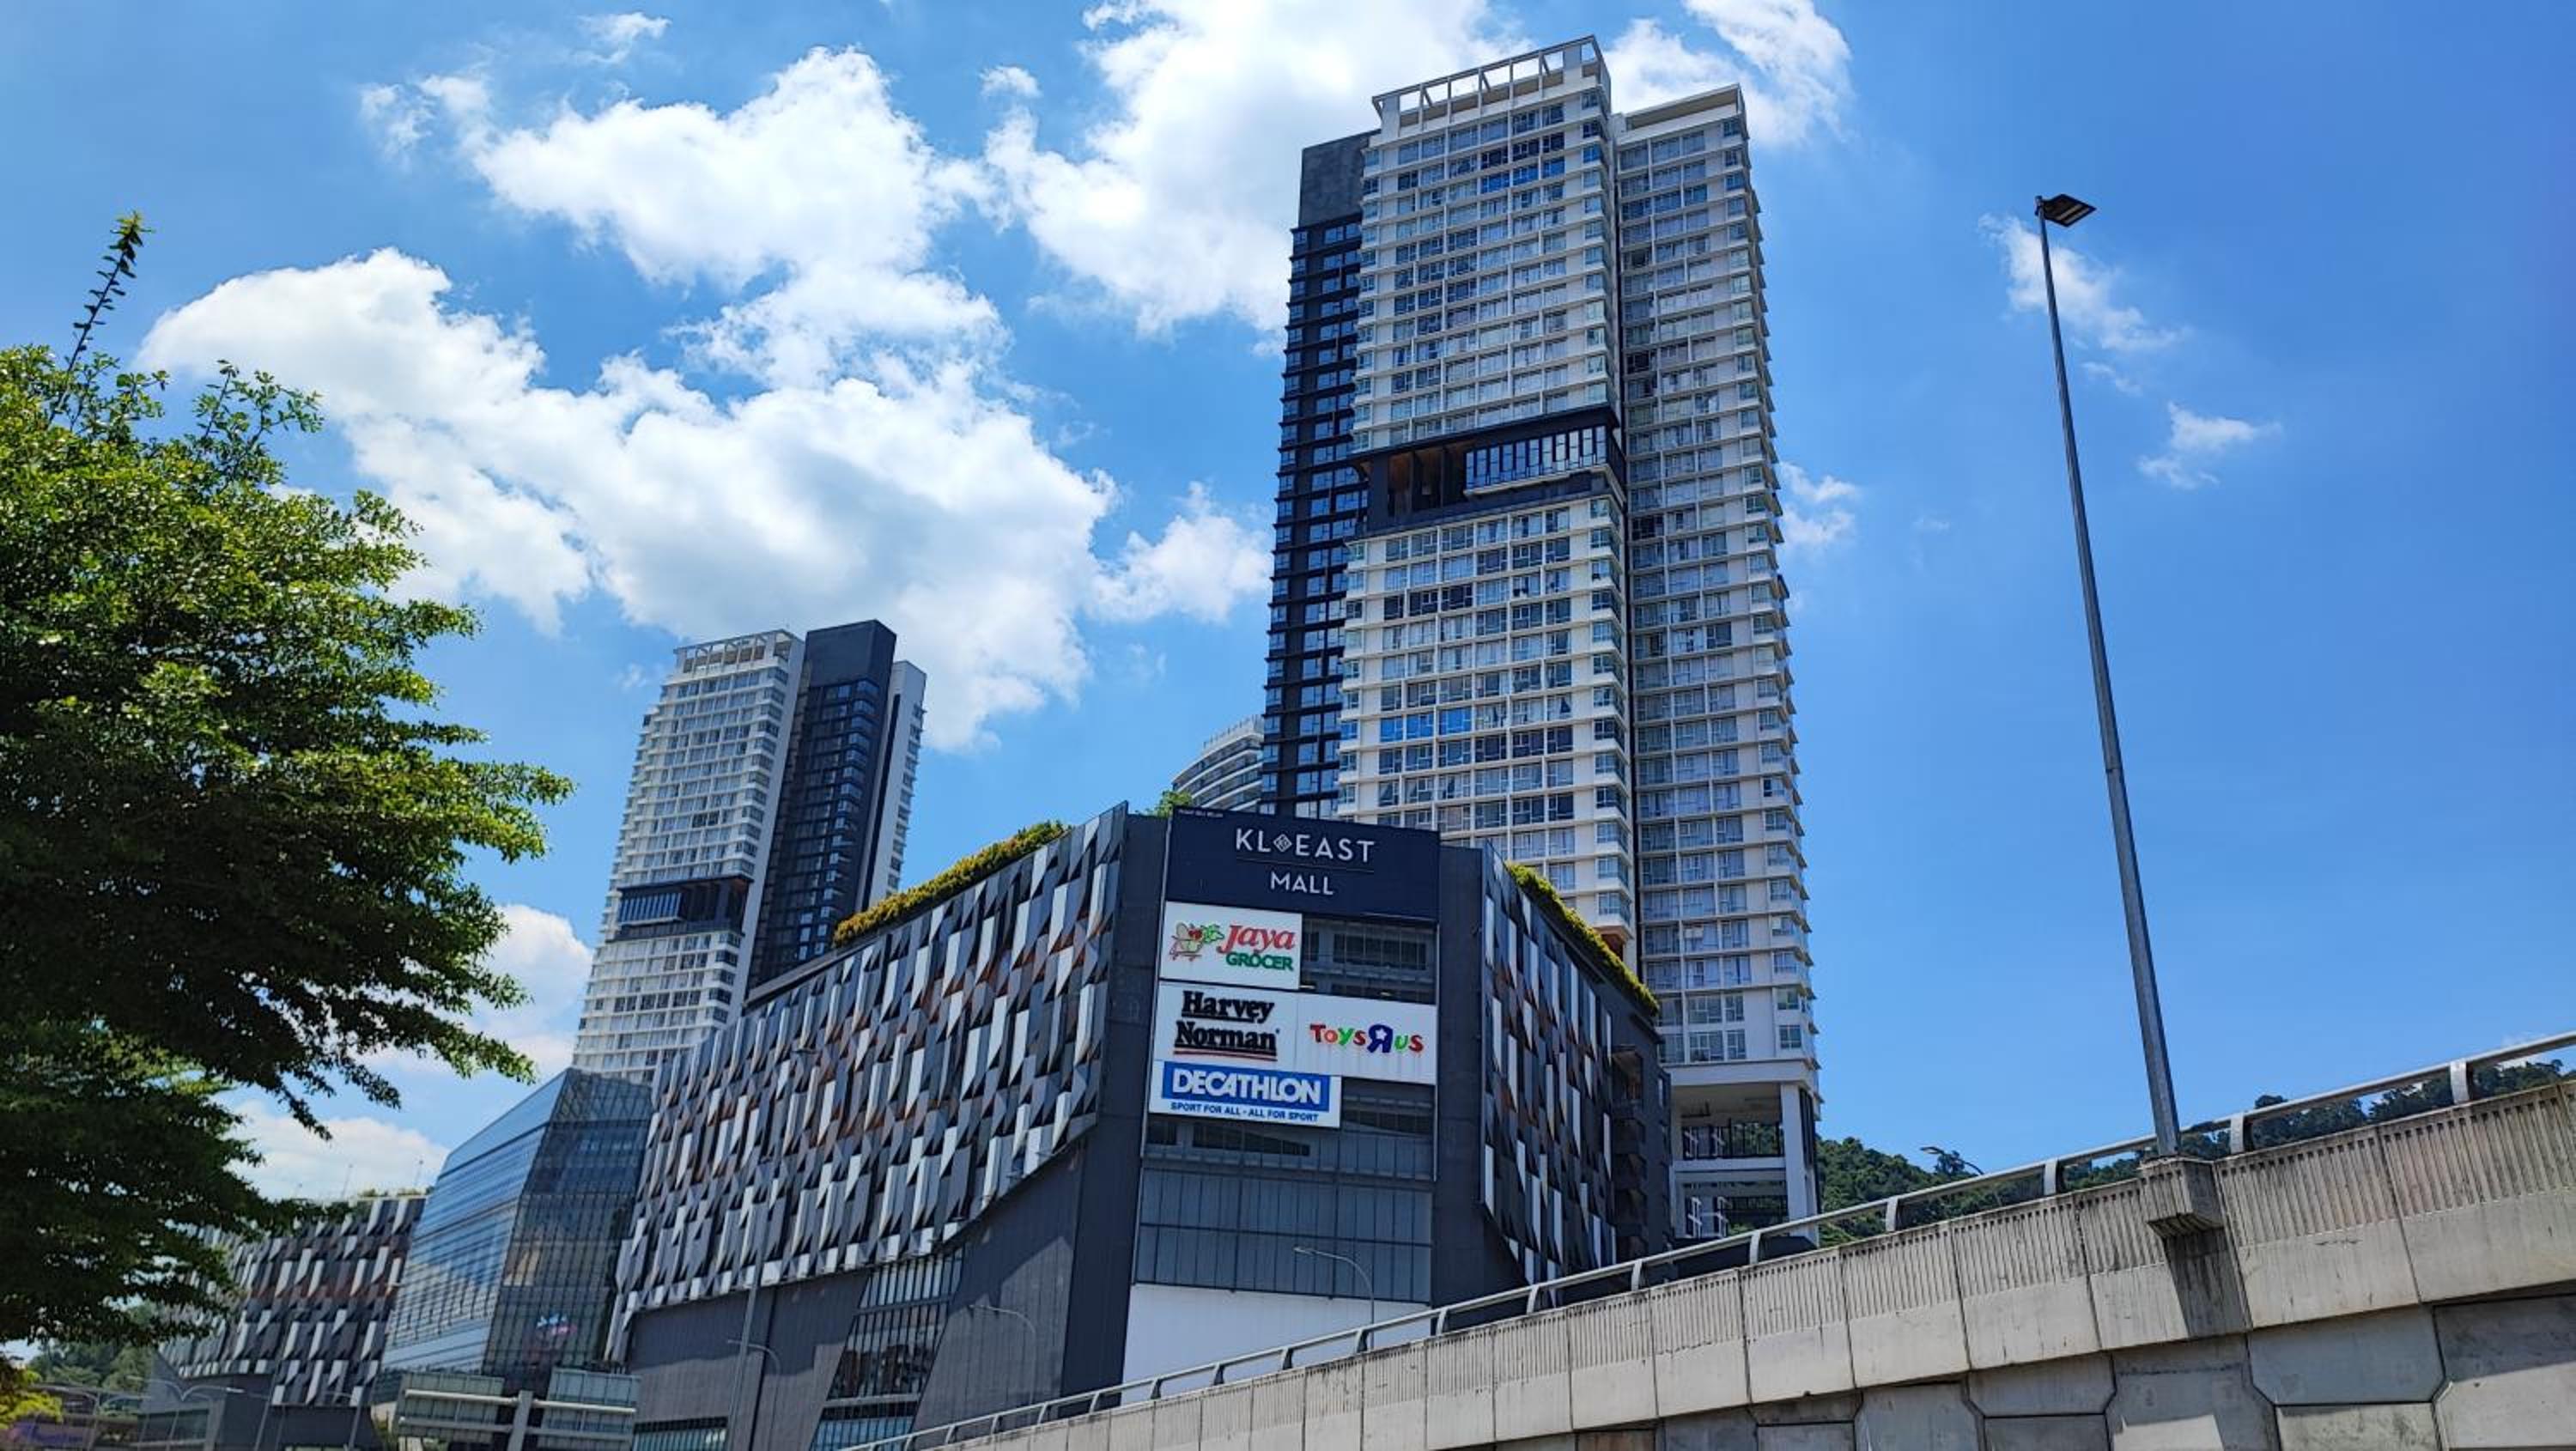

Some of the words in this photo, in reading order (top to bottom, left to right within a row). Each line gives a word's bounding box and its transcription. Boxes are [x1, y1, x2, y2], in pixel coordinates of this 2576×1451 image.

[1236, 829, 1271, 853] KL
[1296, 835, 1375, 863] EAST
[1270, 871, 1334, 895] MALL
[1217, 924, 1296, 954] Jaya
[1225, 952, 1294, 971] GROCER
[1182, 990, 1274, 1024] Harvey
[1175, 1020, 1277, 1051] Norman
[1171, 1067, 1321, 1106] DECATHLON
[1170, 1102, 1201, 1114] SPORT
[1203, 1104, 1222, 1114] FOR
[1224, 1107, 1242, 1116] ALL
[1248, 1108, 1265, 1118] ALL
[1267, 1109, 1286, 1120] FOR
[1288, 1112, 1319, 1122] SPORT
